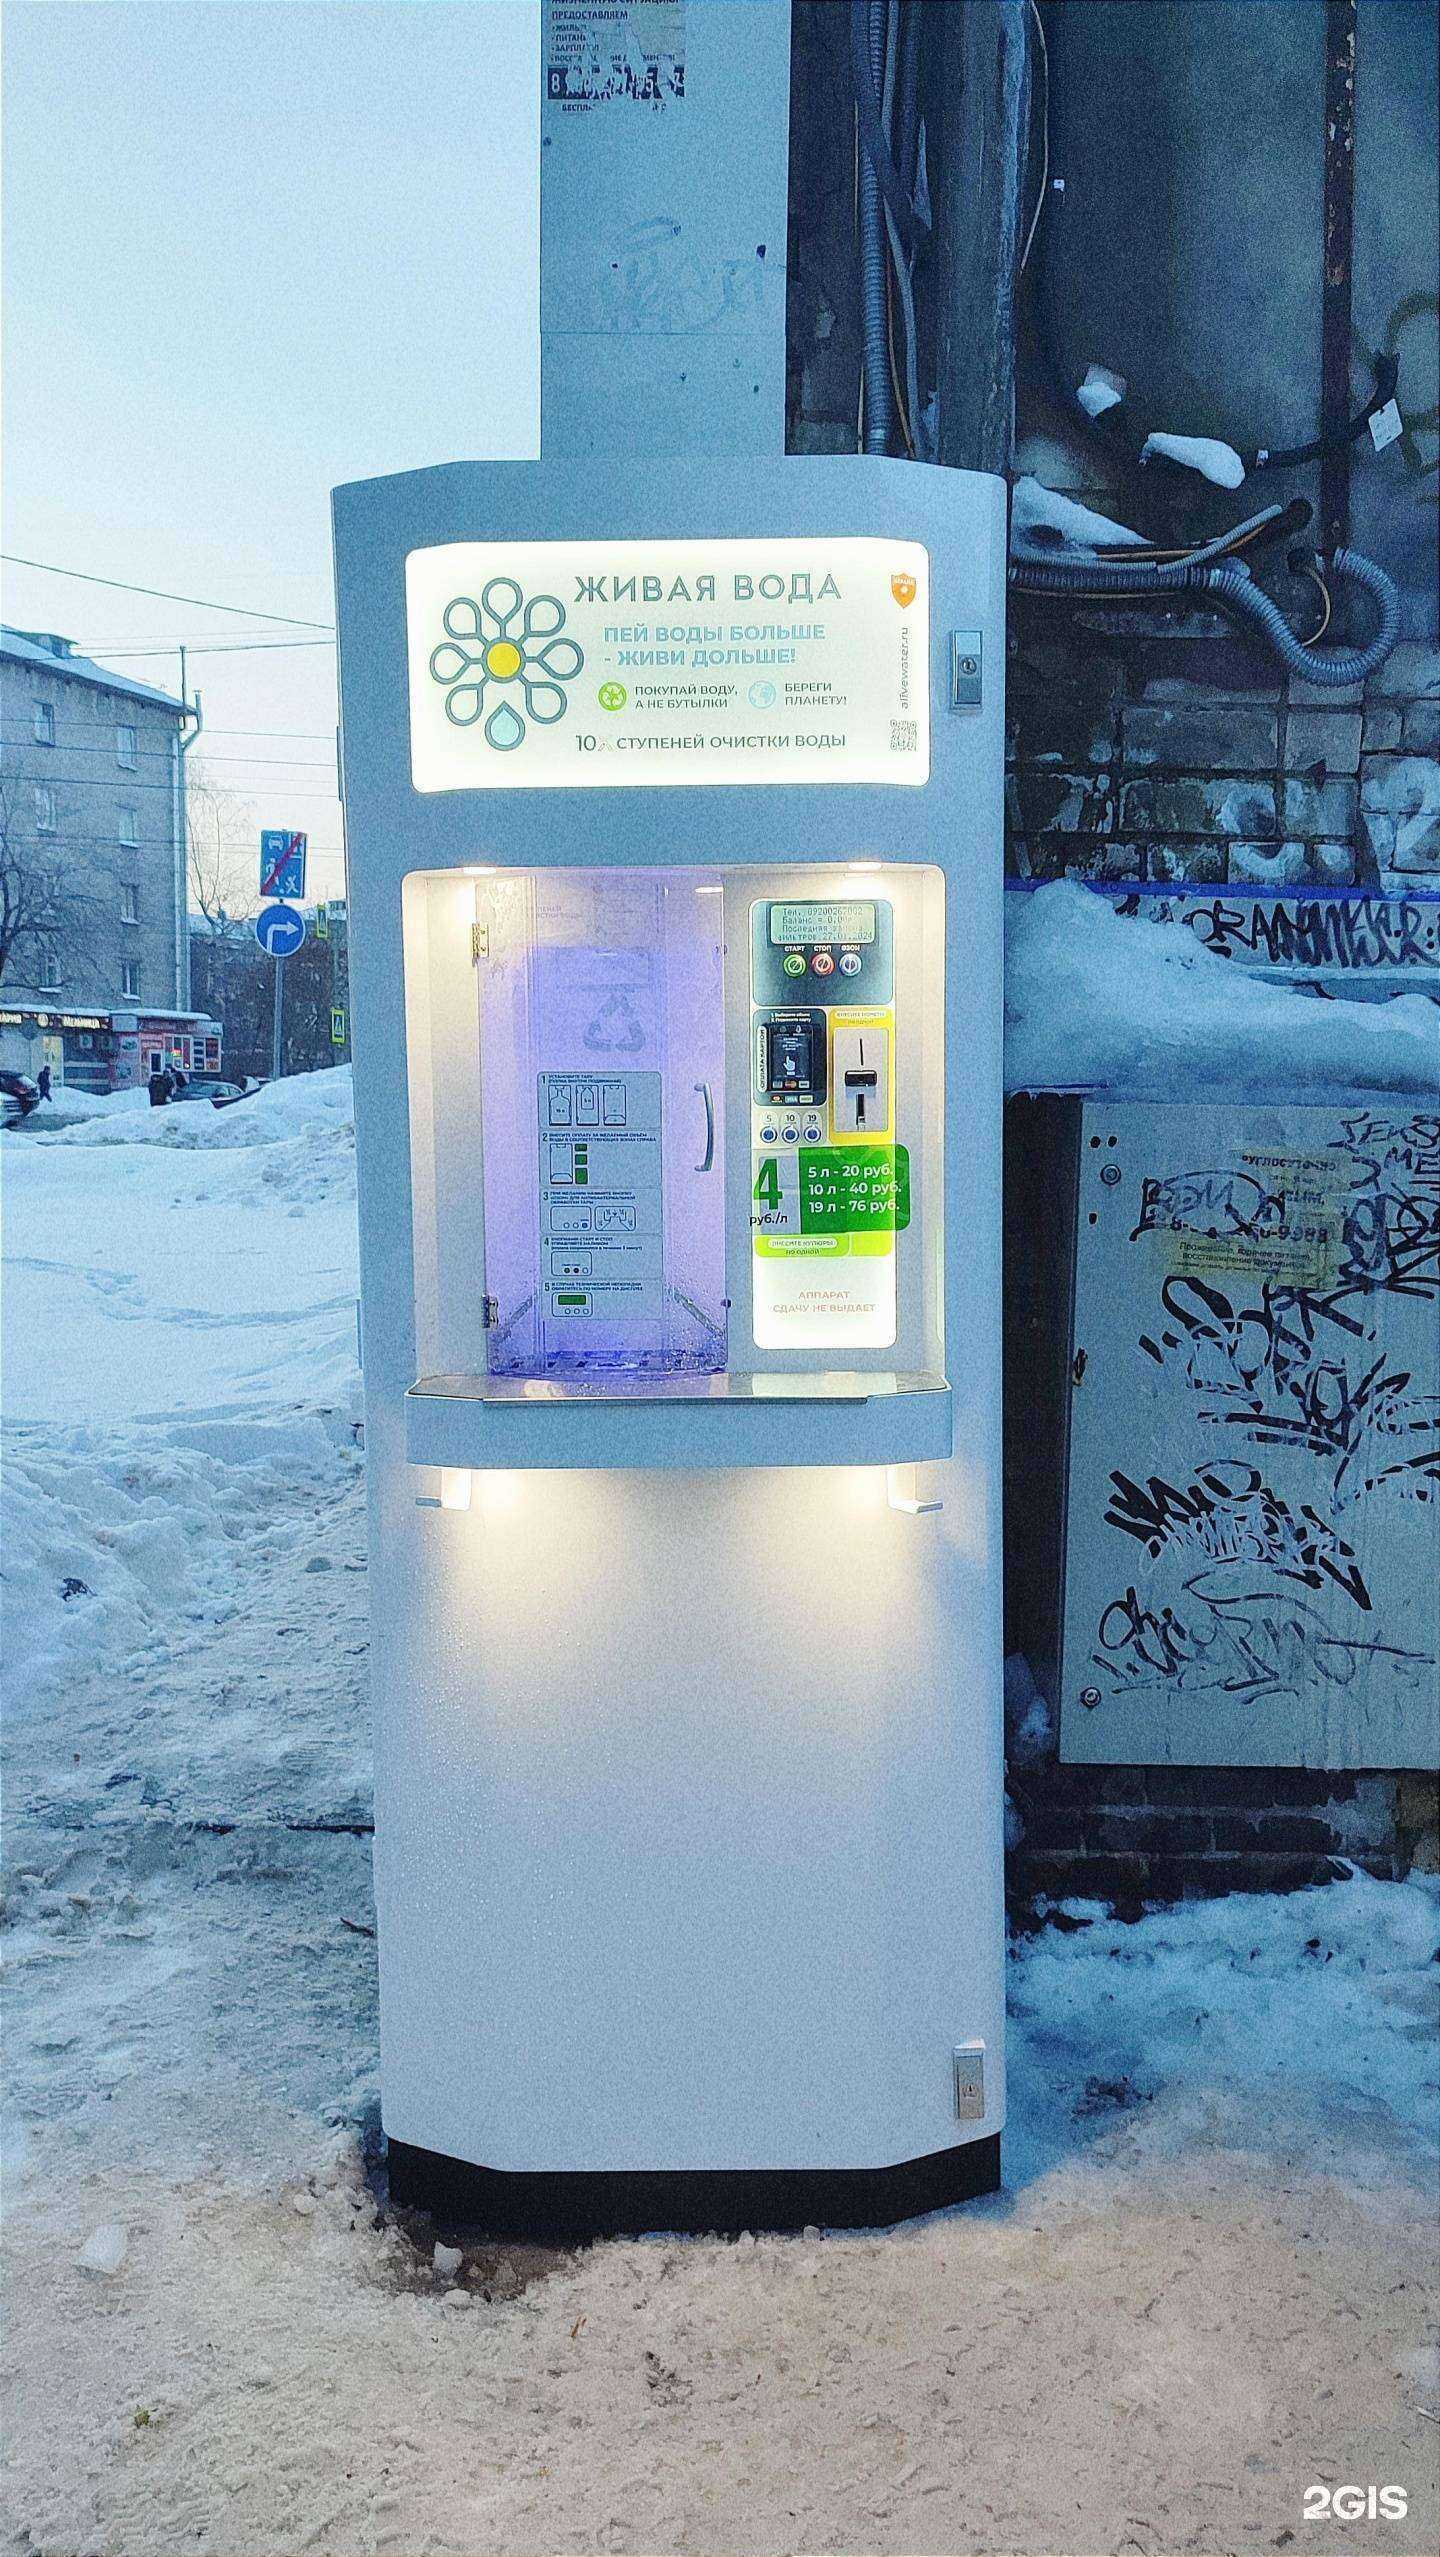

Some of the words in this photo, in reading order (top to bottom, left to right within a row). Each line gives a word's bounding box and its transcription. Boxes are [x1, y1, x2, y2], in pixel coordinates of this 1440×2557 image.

[573, 575, 716, 603] ЖИВАЯ
[733, 574, 842, 604] ВОДА
[604, 622, 648, 643] ПЕЙ
[655, 625, 723, 644] ВОДЫ
[730, 624, 826, 642] БОЛЬШЕ
[617, 649, 685, 666] ЖИВИ
[691, 647, 796, 667] ДОЛЬШЕ!
[899, 627, 909, 709] alivewater.ru
[635, 683, 697, 696] ПОКУПАЙ
[700, 685, 738, 696] ВОДУ,
[785, 682, 832, 693] БЕРЕГИ
[635, 699, 644, 709] А
[647, 699, 664, 709] НЕ
[667, 699, 728, 709] БУТЫЛКИ
[785, 695, 847, 706] ПЛАНЕТУ!
[575, 735, 597, 752] 10
[617, 734, 705, 750] СТУПЕНЕЙ
[710, 735, 789, 748] ОЧИСТКИ
[795, 734, 846, 748] ВОДЫ
[813, 945, 832, 953] СТОП
[808, 1167, 817, 1178] 5
[820, 1167, 830, 1178] л
[842, 1165, 859, 1177] 20
[863, 1164, 894, 1179] руб.
[753, 1158, 783, 1210] 4
[809, 1184, 824, 1195] 10
[826, 1185, 837, 1195] л
[850, 1182, 868, 1194] 40
[872, 1180, 902, 1195] руб.
[809, 1202, 824, 1213] 19
[826, 1203, 837, 1212] л
[850, 1200, 867, 1212] 76
[870, 1198, 900, 1213] руб.
[750, 1212, 788, 1226] руб./л
[798, 1291, 851, 1300] АППАРАТ
[773, 1304, 810, 1313] СДАЧУ
[813, 1304, 827, 1312] НЕ
[829, 1303, 876, 1313] ВЫДАЕТ
